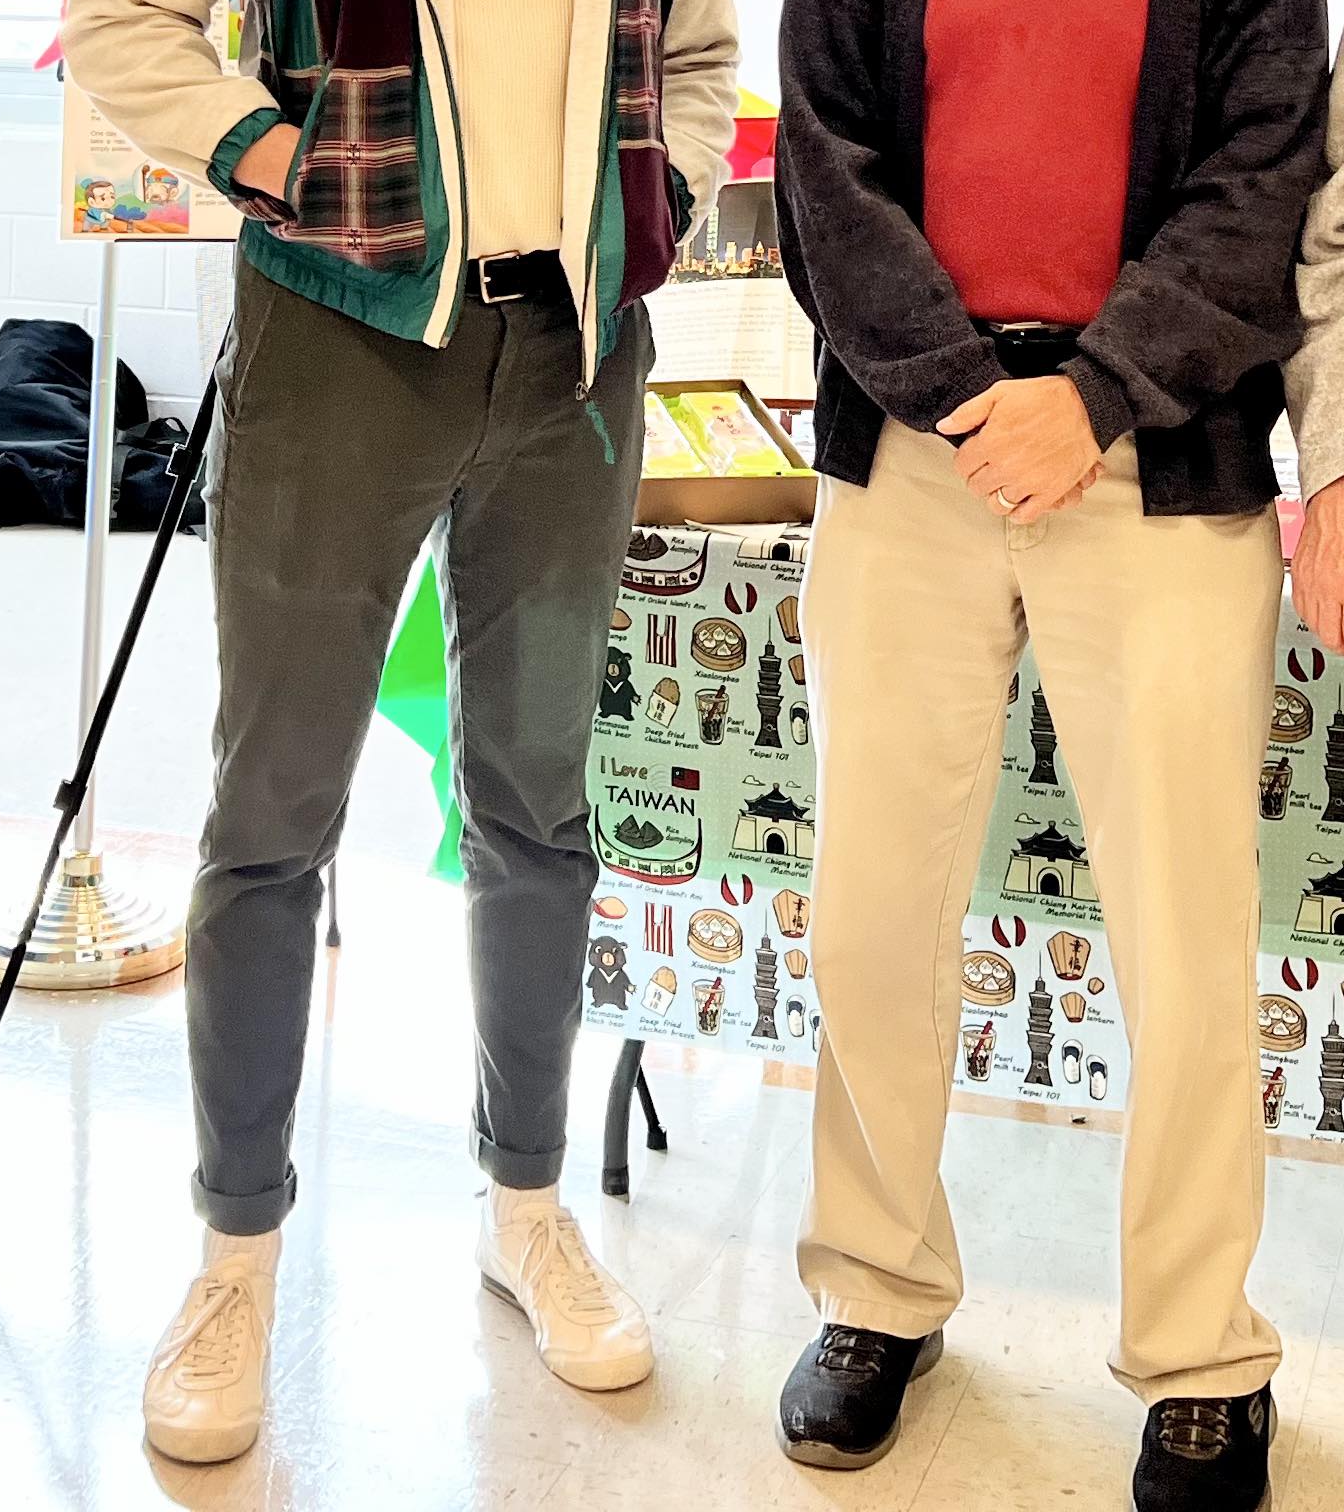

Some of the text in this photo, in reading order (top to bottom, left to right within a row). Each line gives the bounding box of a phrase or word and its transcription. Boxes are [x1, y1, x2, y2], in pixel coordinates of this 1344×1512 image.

[733, 560, 767, 570] National
[770, 565, 796, 575] Chiang
[775, 574, 802, 583] Memo
[610, 634, 627, 642] ango
[694, 670, 740, 683] Xiaolongbao
[645, 726, 685, 740] Deep fried
[749, 749, 789, 760] Taipei 101
[1266, 745, 1305, 755] olongbao
[1002, 755, 1017, 763] earl
[600, 755, 648, 780] I Love
[1023, 786, 1066, 798] Taipei 101
[605, 785, 695, 816] TAIWAN
[1315, 824, 1341, 835] Taipei
[728, 851, 813, 871] National Chiang Kai-
[770, 867, 808, 879] Memorial
[1000, 892, 1102, 913] National Chiang Kai-she
[1045, 908, 1085, 920] Memorial
[597, 921, 624, 931] Mango
[1290, 933, 1328, 945] National
[690, 960, 736, 975] Xiaolongbao
[746, 1039, 769, 1050] Taipei
[1261, 1053, 1299, 1065] olongbao
[1018, 1087, 1061, 1101] Taipei 101
